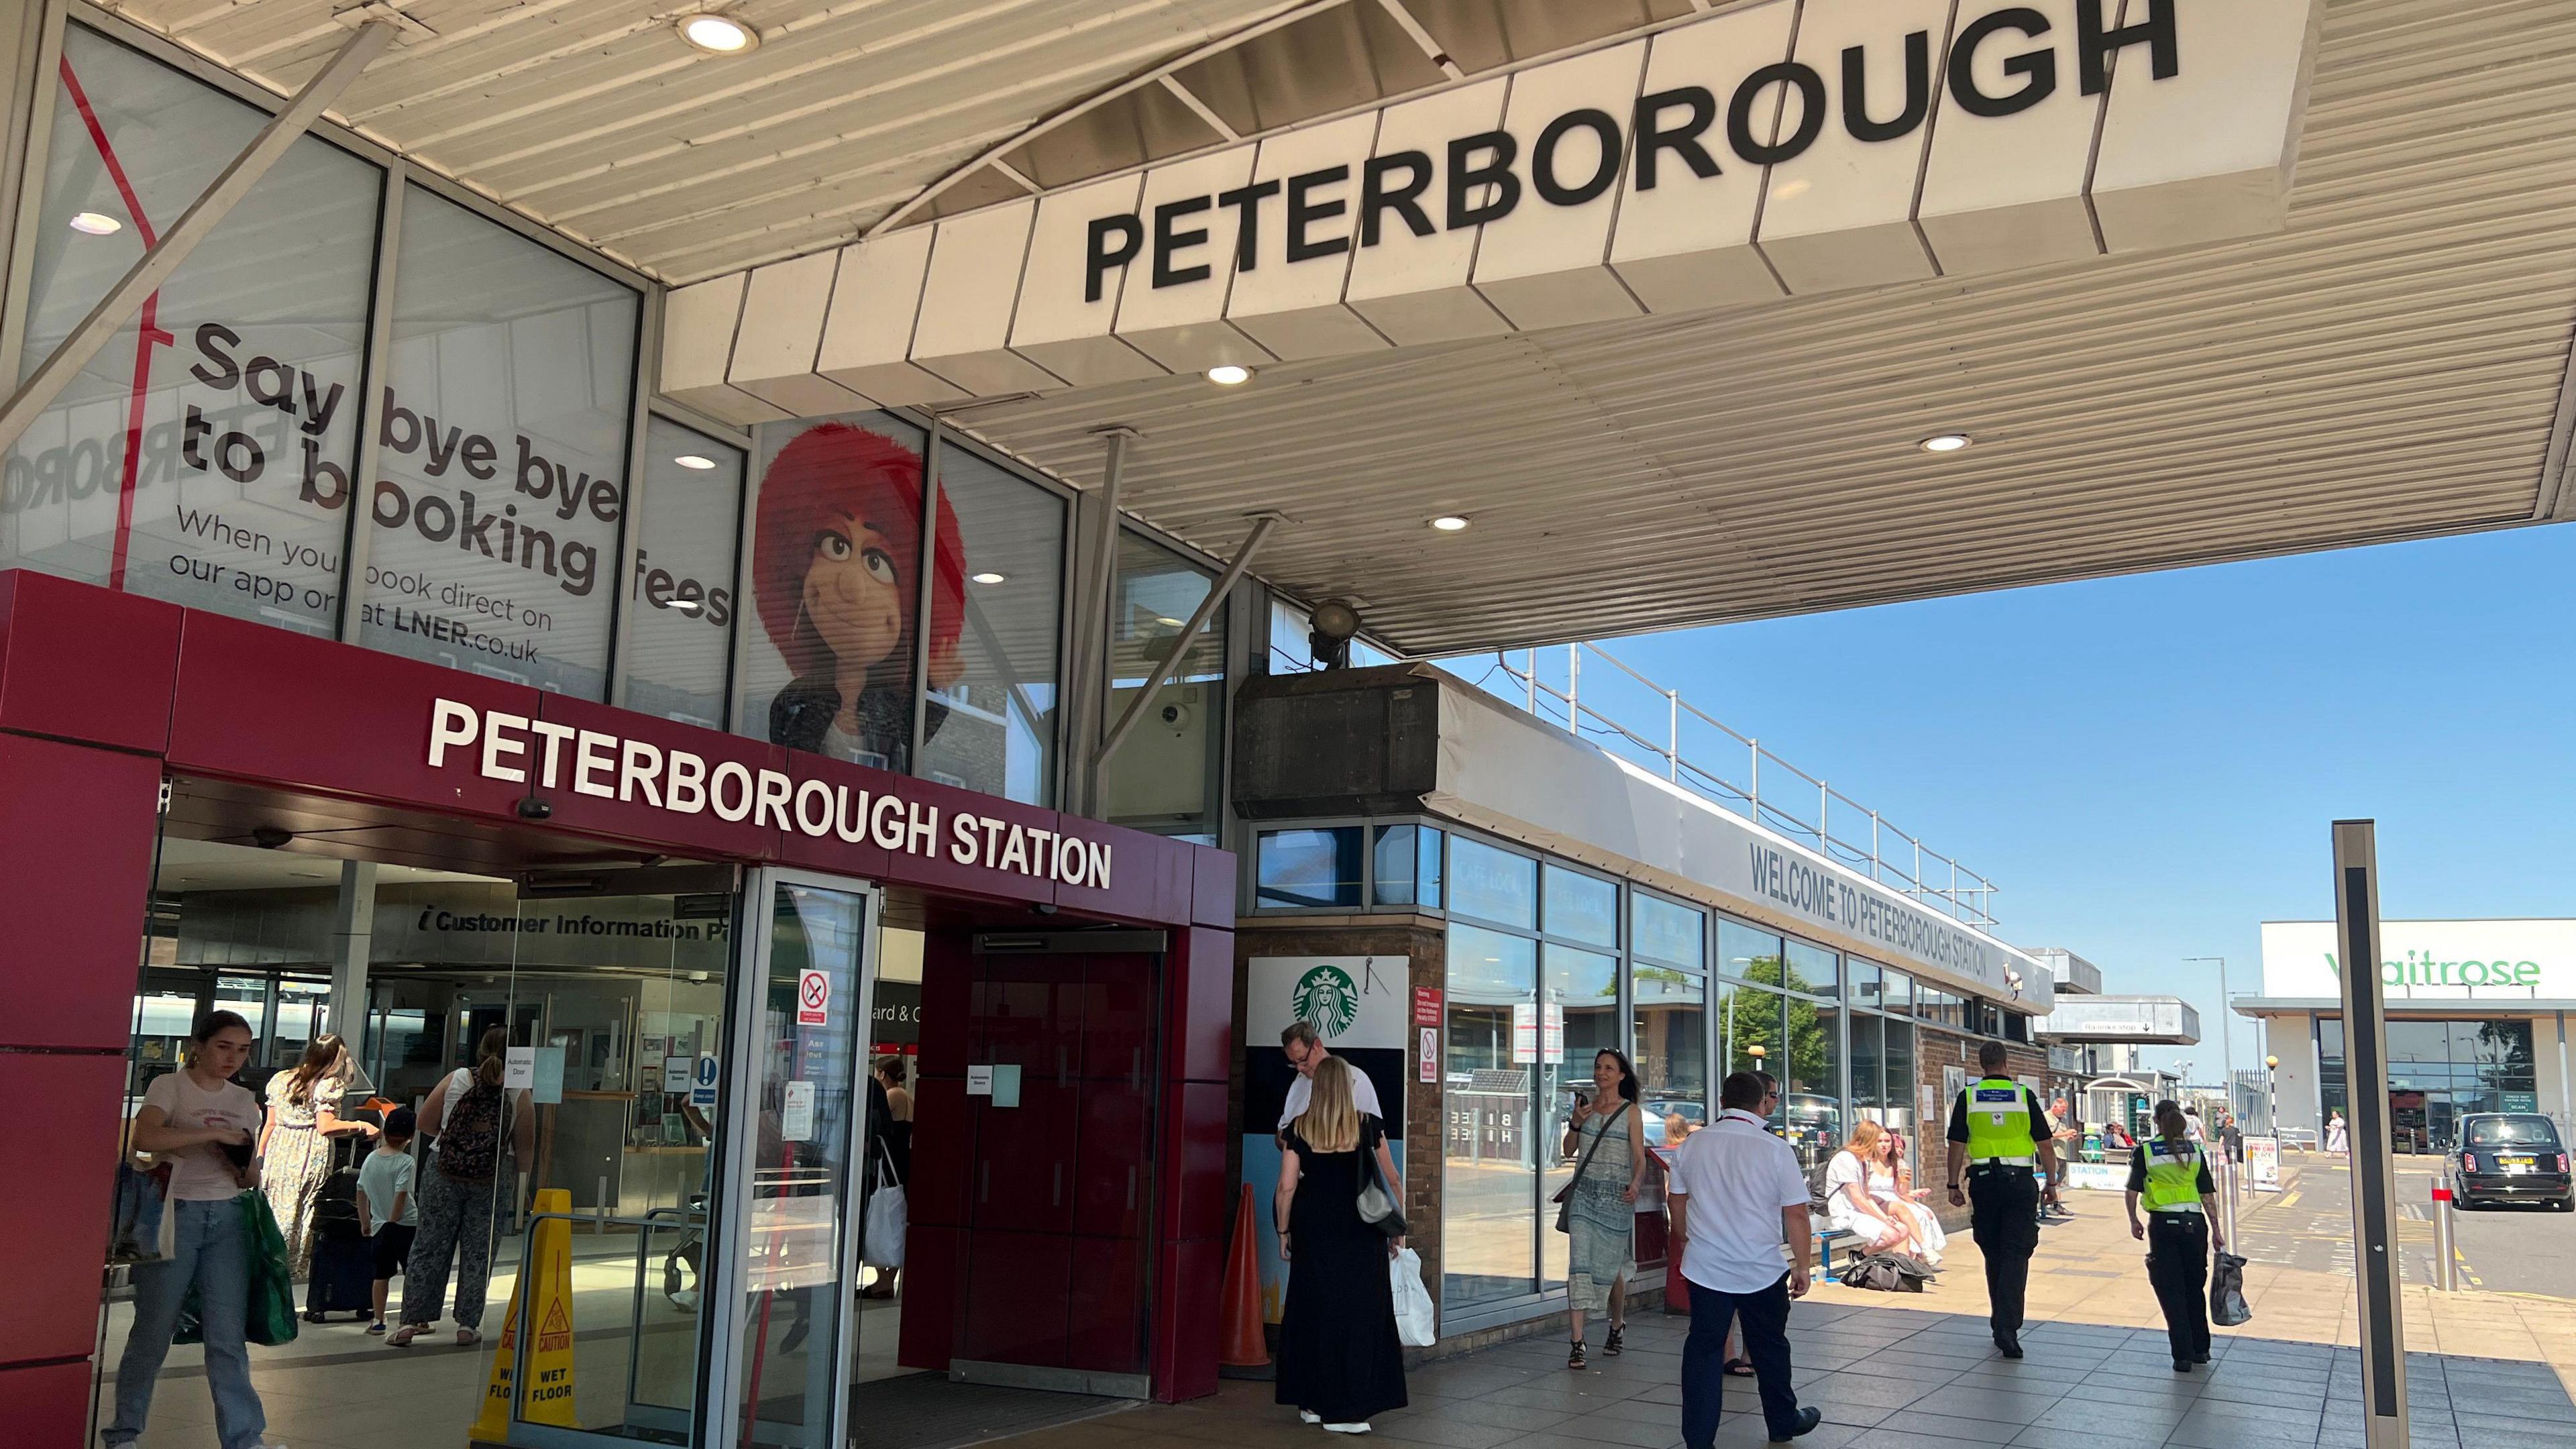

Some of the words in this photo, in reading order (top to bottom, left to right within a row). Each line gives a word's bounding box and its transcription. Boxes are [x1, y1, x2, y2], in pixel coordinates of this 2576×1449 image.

[1084, 0, 2178, 303] PETERBOROUGH
[189, 323, 345, 436] Say
[379, 386, 498, 480] bye
[515, 434, 620, 523] bye
[176, 504, 271, 555] When
[282, 541, 337, 574] you
[441, 582, 514, 622] direct
[523, 608, 552, 632] on
[182, 404, 265, 483] to
[299, 437, 597, 596] booking
[633, 548, 730, 627] fees
[170, 554, 225, 584] our
[235, 570, 294, 605] app
[304, 588, 335, 612] or
[361, 603, 385, 627] at
[394, 606, 538, 664] LNER.co.uk
[428, 698, 936, 857] PETERBOROUGH
[951, 812, 1112, 890] STATION
[437, 910, 549, 933] Customer
[557, 914, 699, 940] Information
[1750, 843, 1835, 922] WELCOME
[1839, 883, 1857, 930] TO
[1860, 893, 1951, 963] PETERBOROUGH
[1953, 933, 1986, 978] STATION
[872, 1004, 896, 1020] ard
[899, 1005, 908, 1022] &
[913, 1006, 921, 1022] C
[2324, 950, 2541, 987] aitrose
[533, 1385, 572, 1402] FLOOR
[539, 1334, 570, 1352] CAUTION
[541, 1368, 566, 1383] WET
